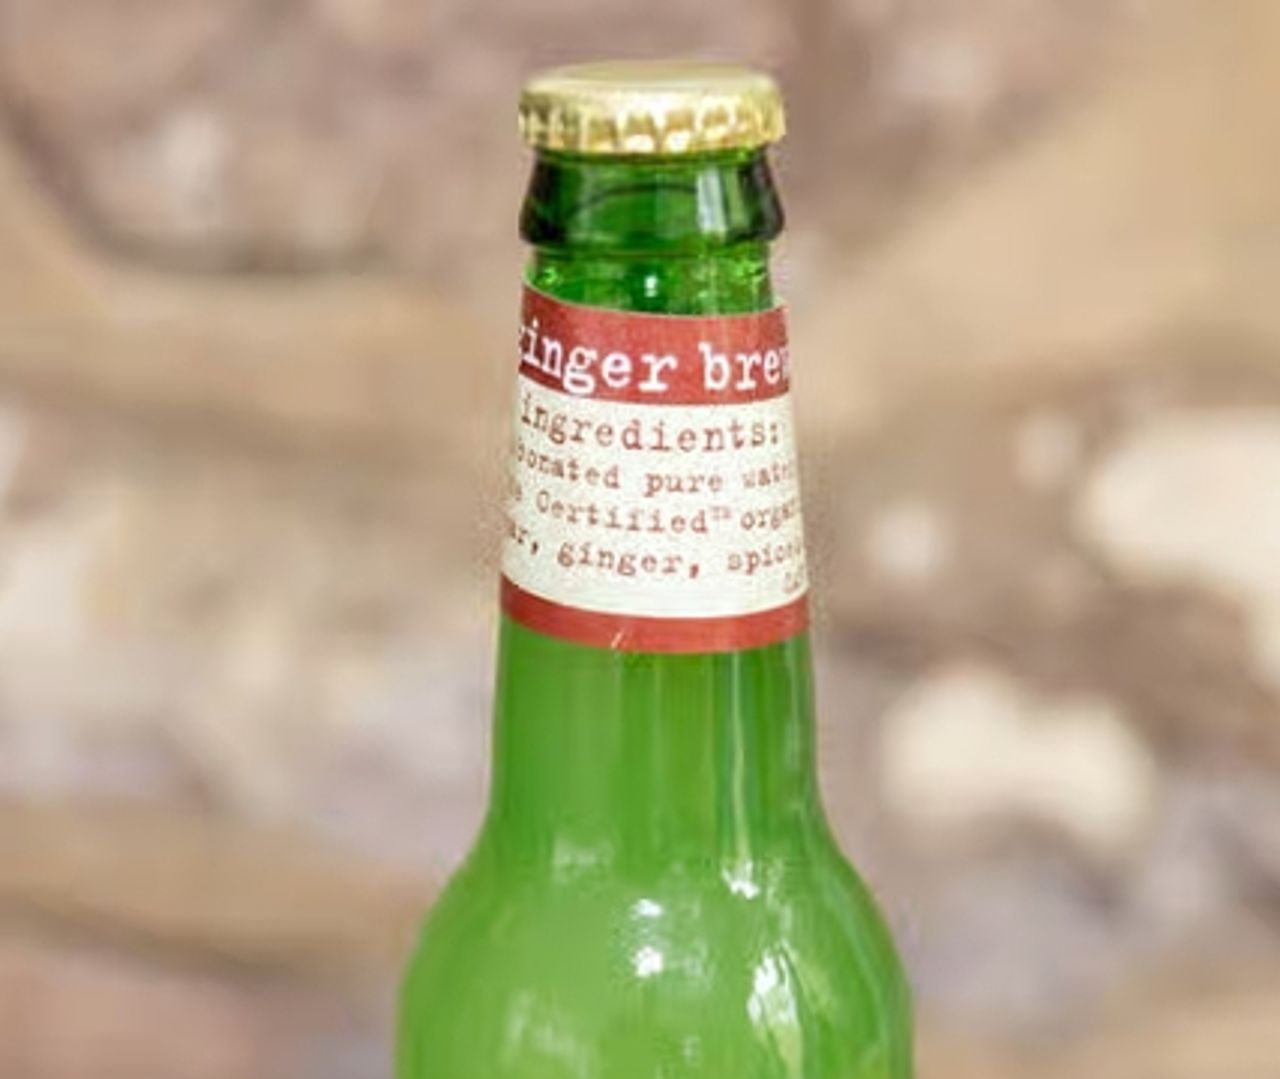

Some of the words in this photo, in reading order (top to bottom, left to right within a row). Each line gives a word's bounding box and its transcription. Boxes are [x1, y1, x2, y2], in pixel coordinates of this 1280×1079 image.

[518, 318, 678, 395] inger
[521, 392, 778, 453] ingredients:
[644, 471, 723, 497] pure
[557, 541, 700, 578] ginger,
